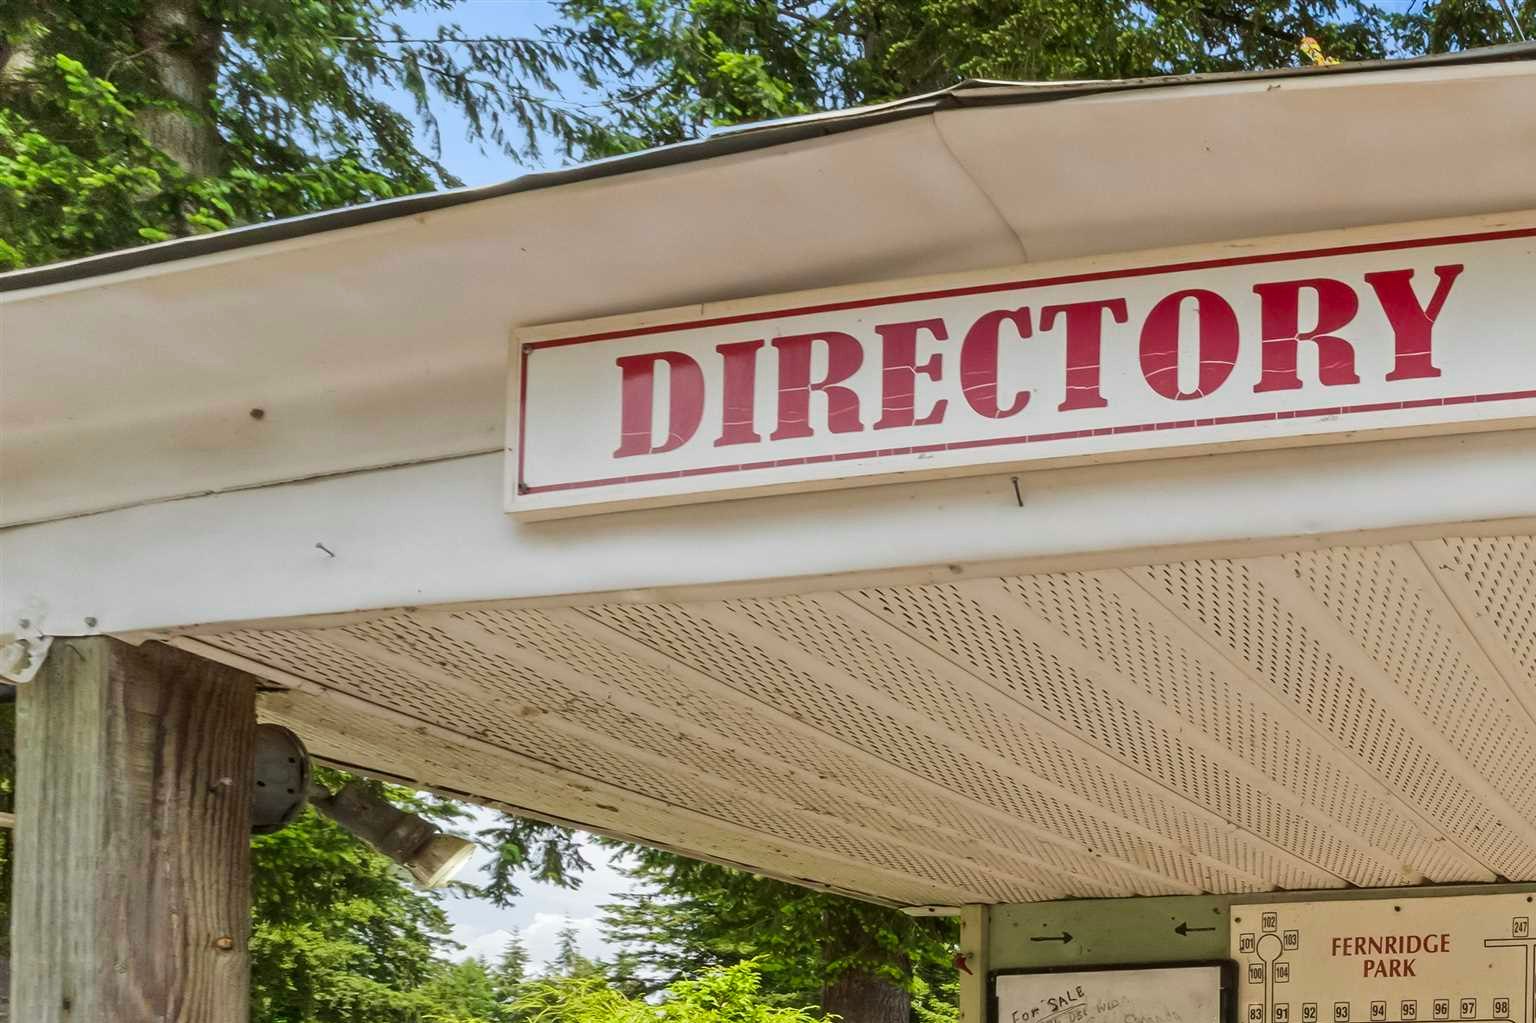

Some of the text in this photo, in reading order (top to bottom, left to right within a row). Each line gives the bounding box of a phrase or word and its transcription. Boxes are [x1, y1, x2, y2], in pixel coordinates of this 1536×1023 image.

[613, 263, 1465, 460] DIRECTORY
[1515, 921, 1527, 932] 247
[1332, 934, 1450, 956] FERNRIDGE
[1250, 968, 1262, 979] 100
[1276, 967, 1288, 977] 104
[1363, 959, 1416, 977] PARK
[1047, 985, 1085, 1011] SALE
[1336, 1007, 1348, 1017] 93
[1373, 1005, 1384, 1016] 94
[1403, 1005, 1415, 1015] 95
[1435, 1004, 1447, 1015] 96
[1462, 1003, 1474, 1014] 97
[1495, 1002, 1507, 1013] 98
[1250, 1009, 1262, 1020] 83
[1276, 1009, 1288, 1019] 91
[1304, 1008, 1316, 1019] 92
